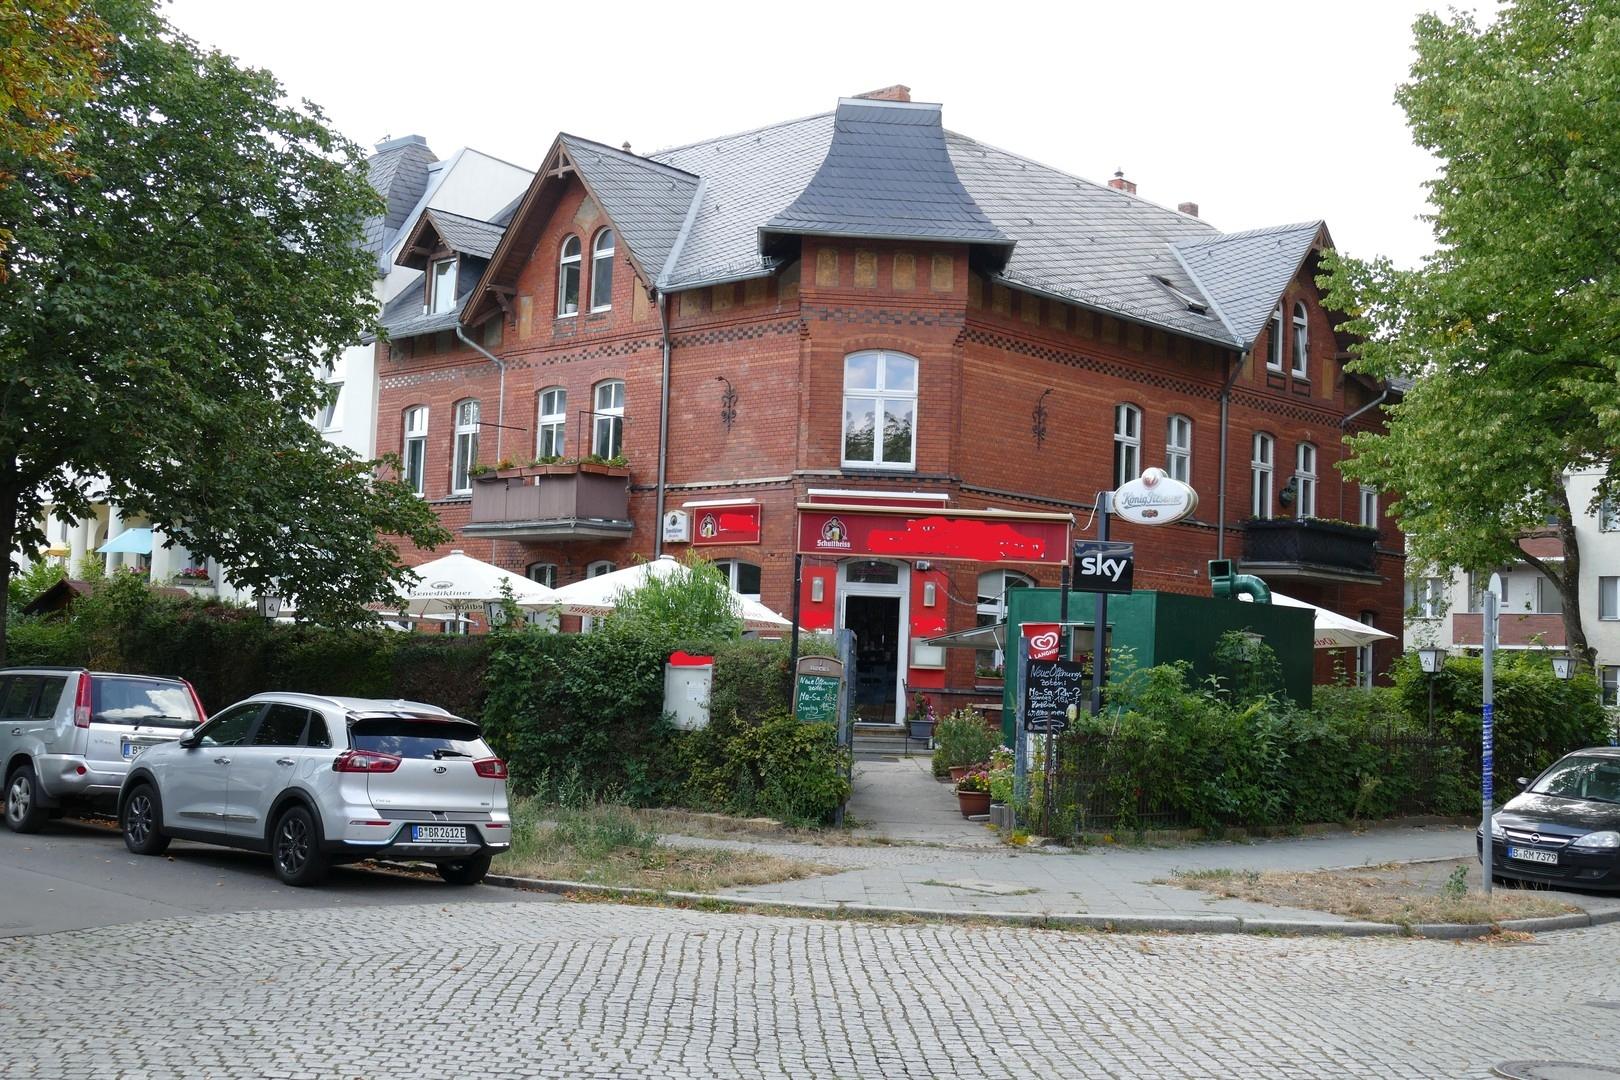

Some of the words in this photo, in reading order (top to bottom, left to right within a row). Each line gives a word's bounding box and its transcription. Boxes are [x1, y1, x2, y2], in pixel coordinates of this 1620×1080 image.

[816, 540, 851, 548] Schultheiss
[1081, 553, 1127, 582] sky
[1034, 648, 1059, 659] LANGNE
[1536, 851, 1557, 862] 7379
